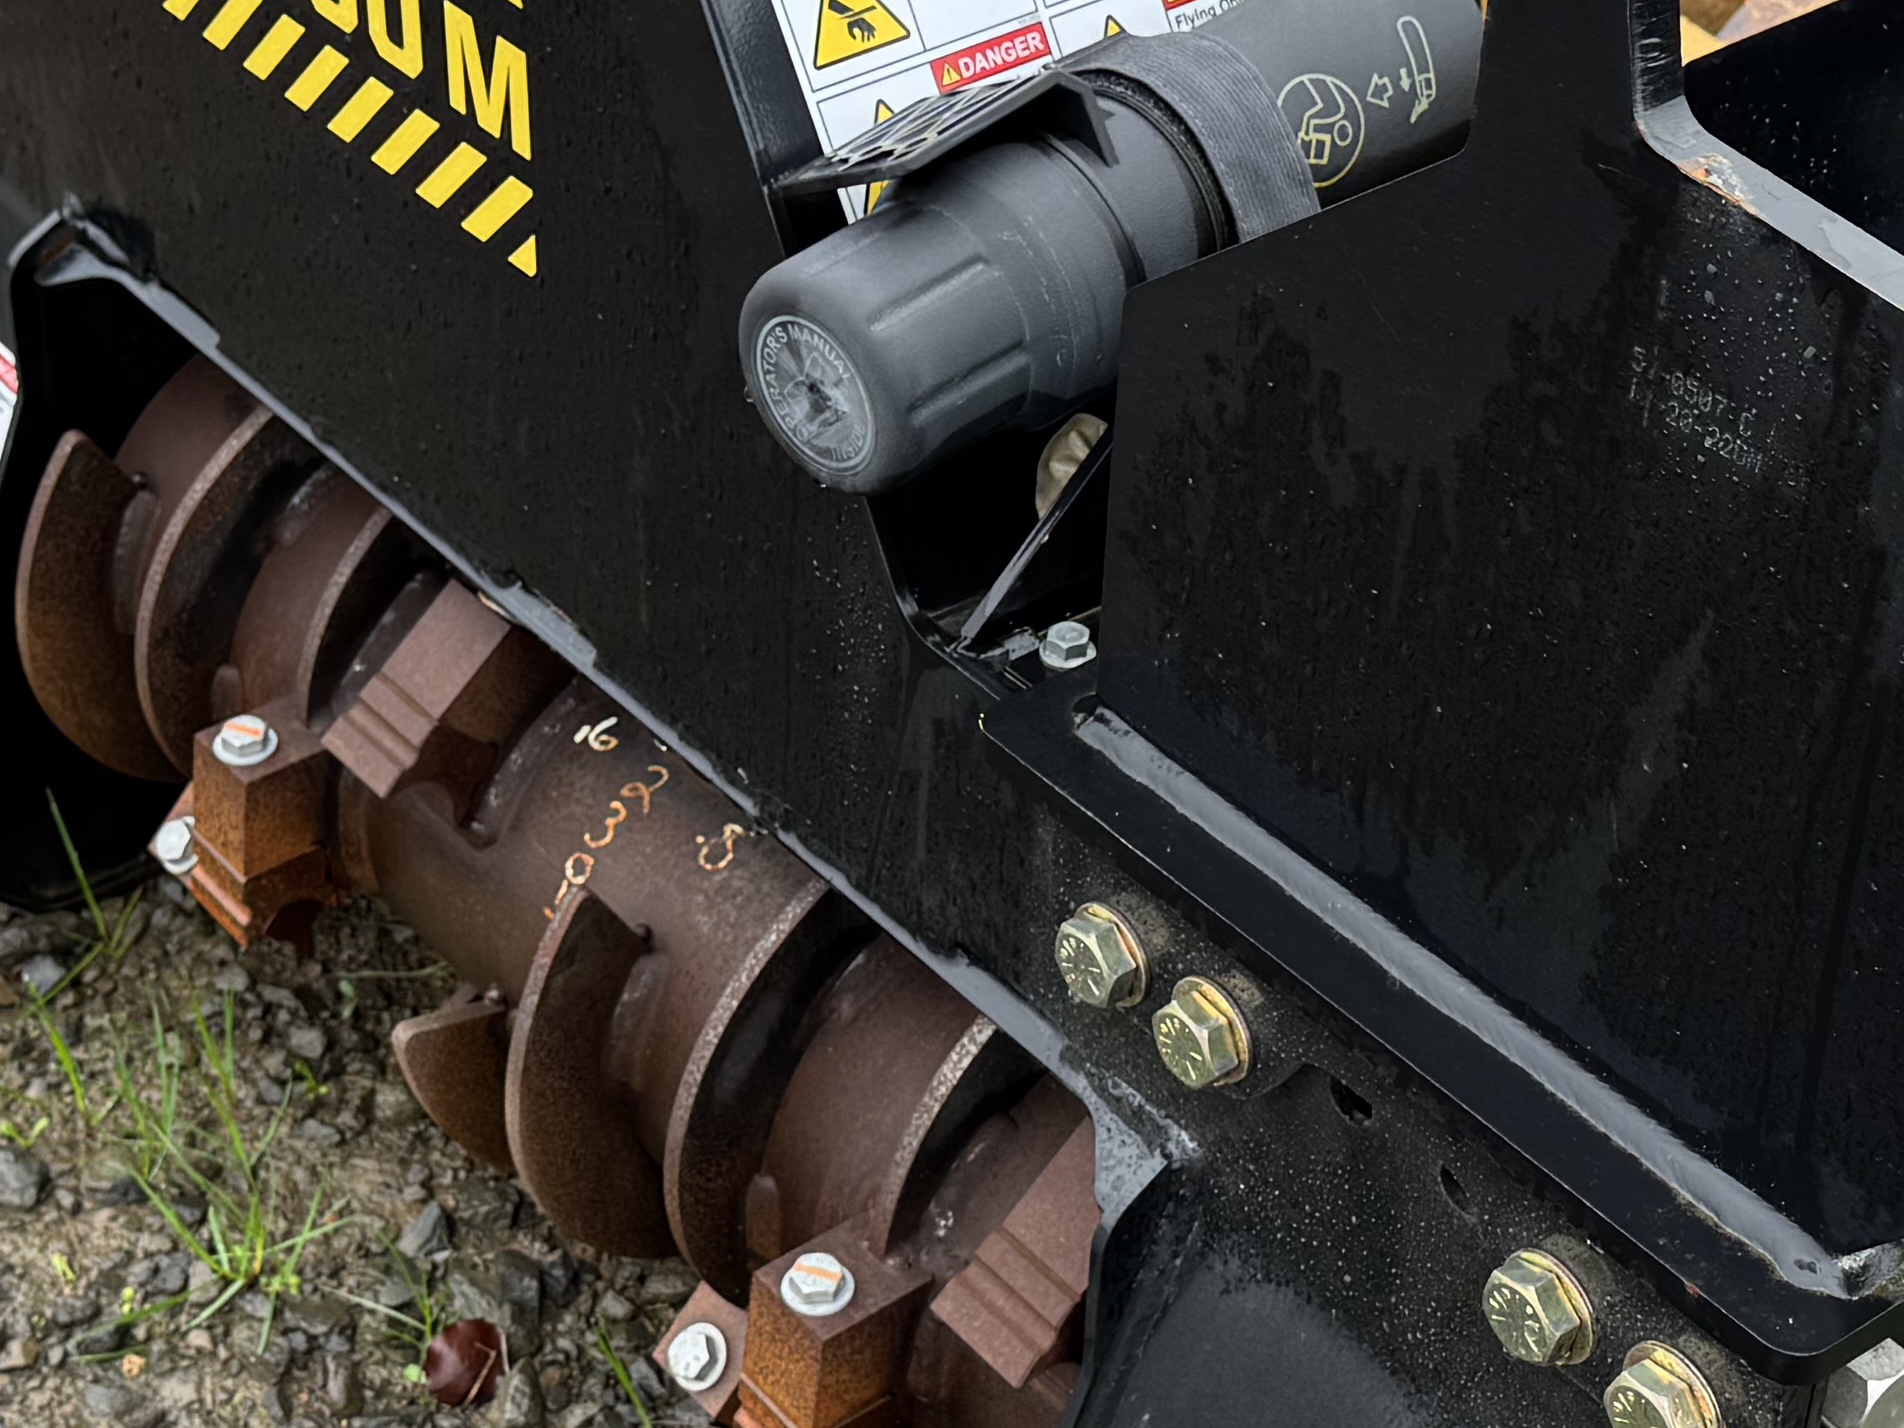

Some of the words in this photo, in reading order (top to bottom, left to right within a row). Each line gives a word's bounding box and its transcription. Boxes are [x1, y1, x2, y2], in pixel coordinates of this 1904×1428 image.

[1175, 6, 1216, 30] Flying
[958, 31, 1045, 78] DANGER
[763, 326, 808, 441] OPERATOR'S
[787, 324, 850, 379] MANUAL
